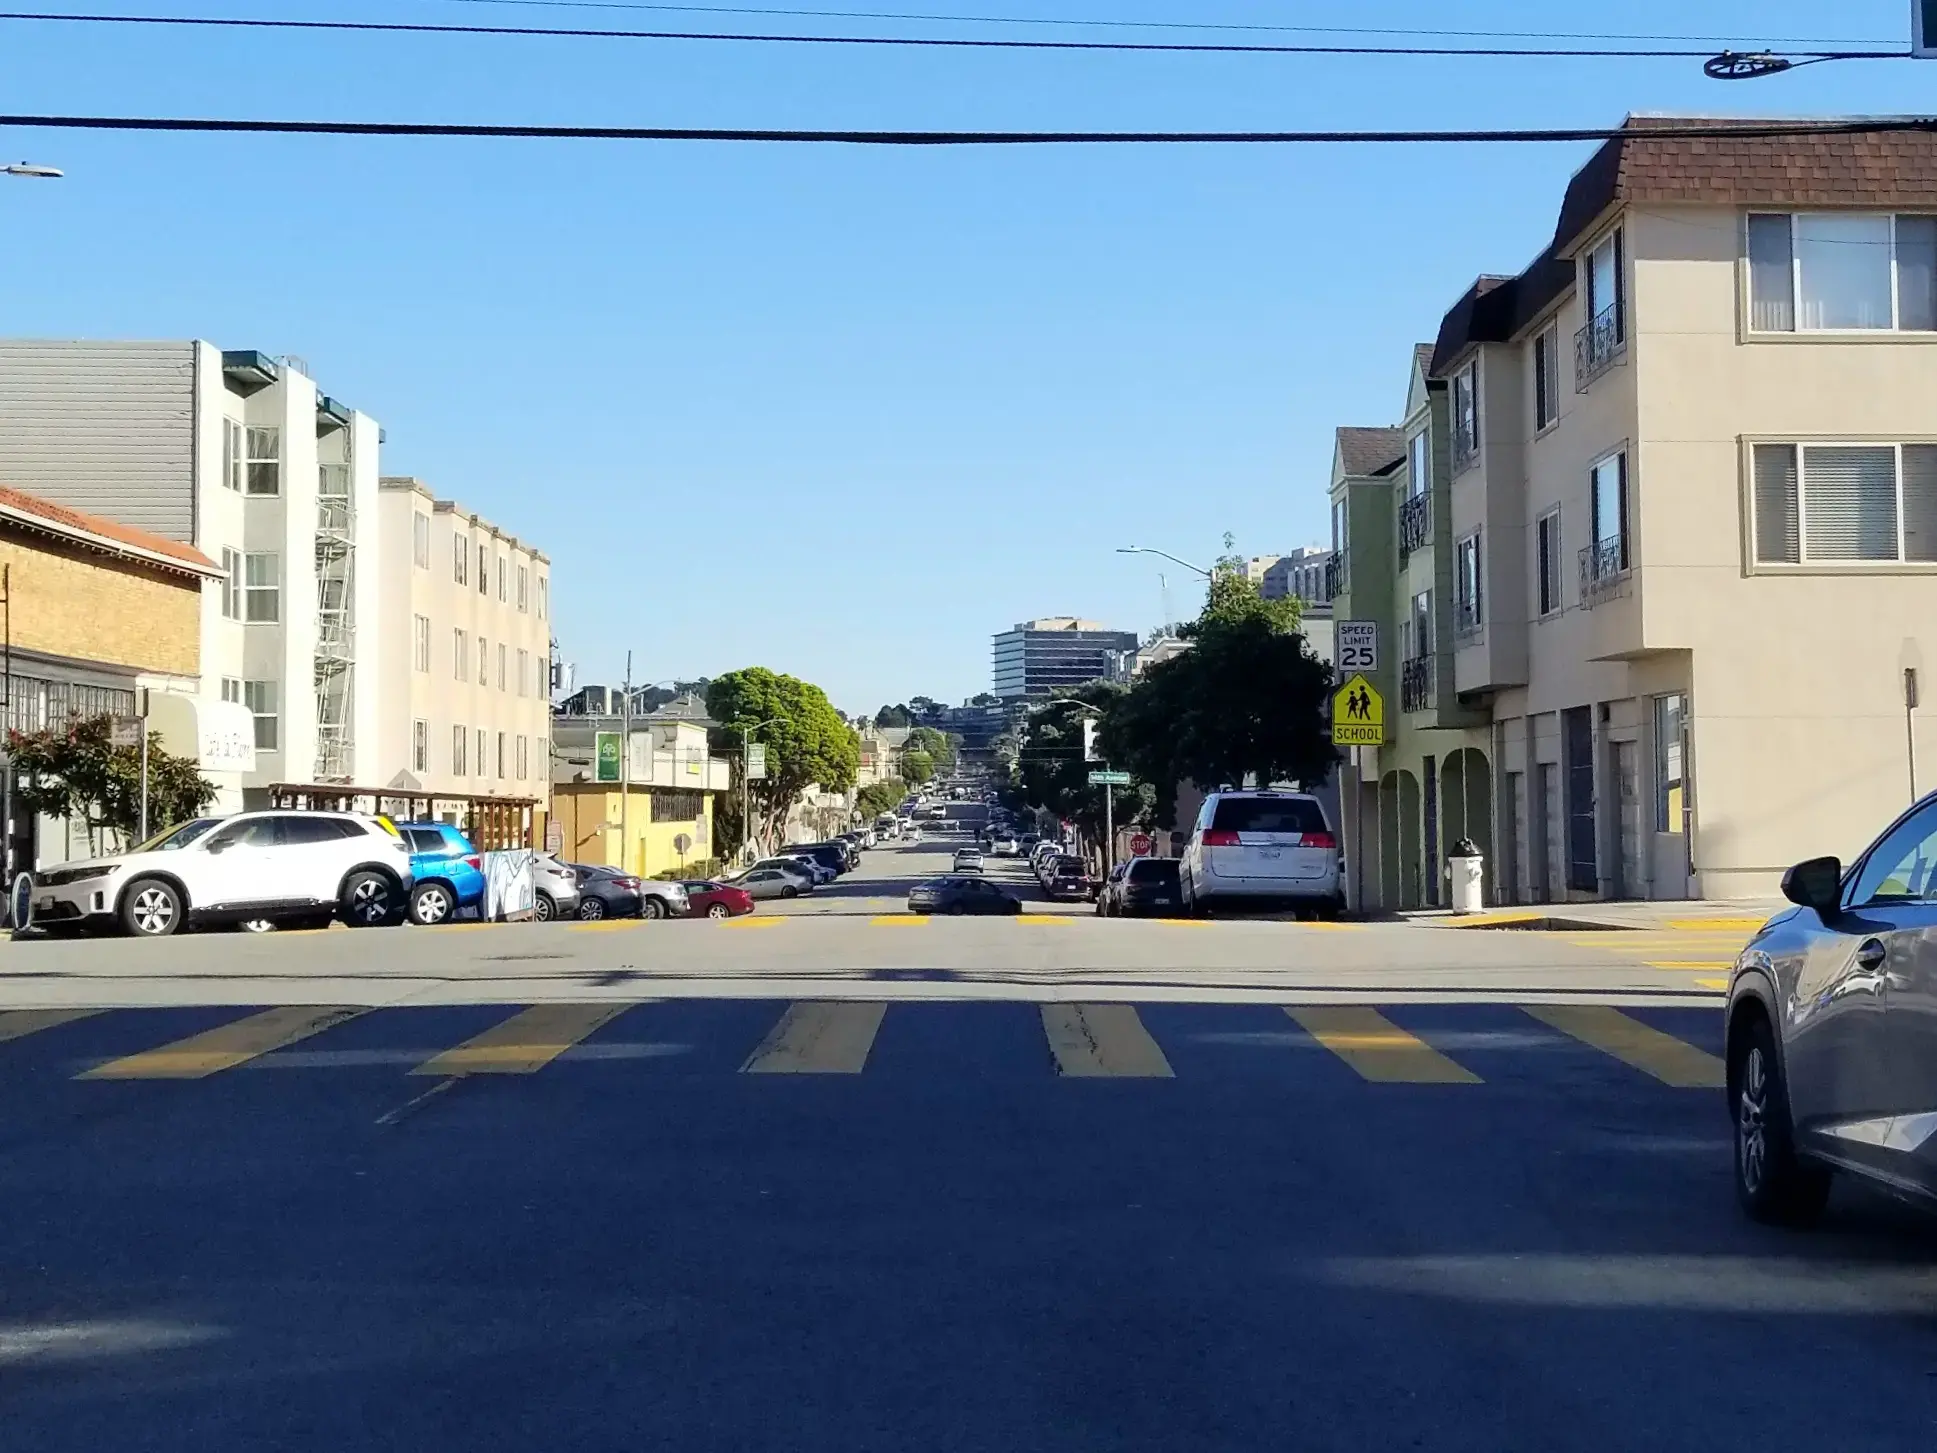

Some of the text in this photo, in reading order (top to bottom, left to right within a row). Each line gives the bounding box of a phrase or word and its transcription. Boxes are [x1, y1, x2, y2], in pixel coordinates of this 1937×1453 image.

[1341, 626, 1374, 634] SPEED
[1344, 637, 1371, 645] LIMIT
[1341, 647, 1374, 666] 25
[1336, 727, 1381, 740] SCHOOL
[1131, 840, 1149, 849] STOP
